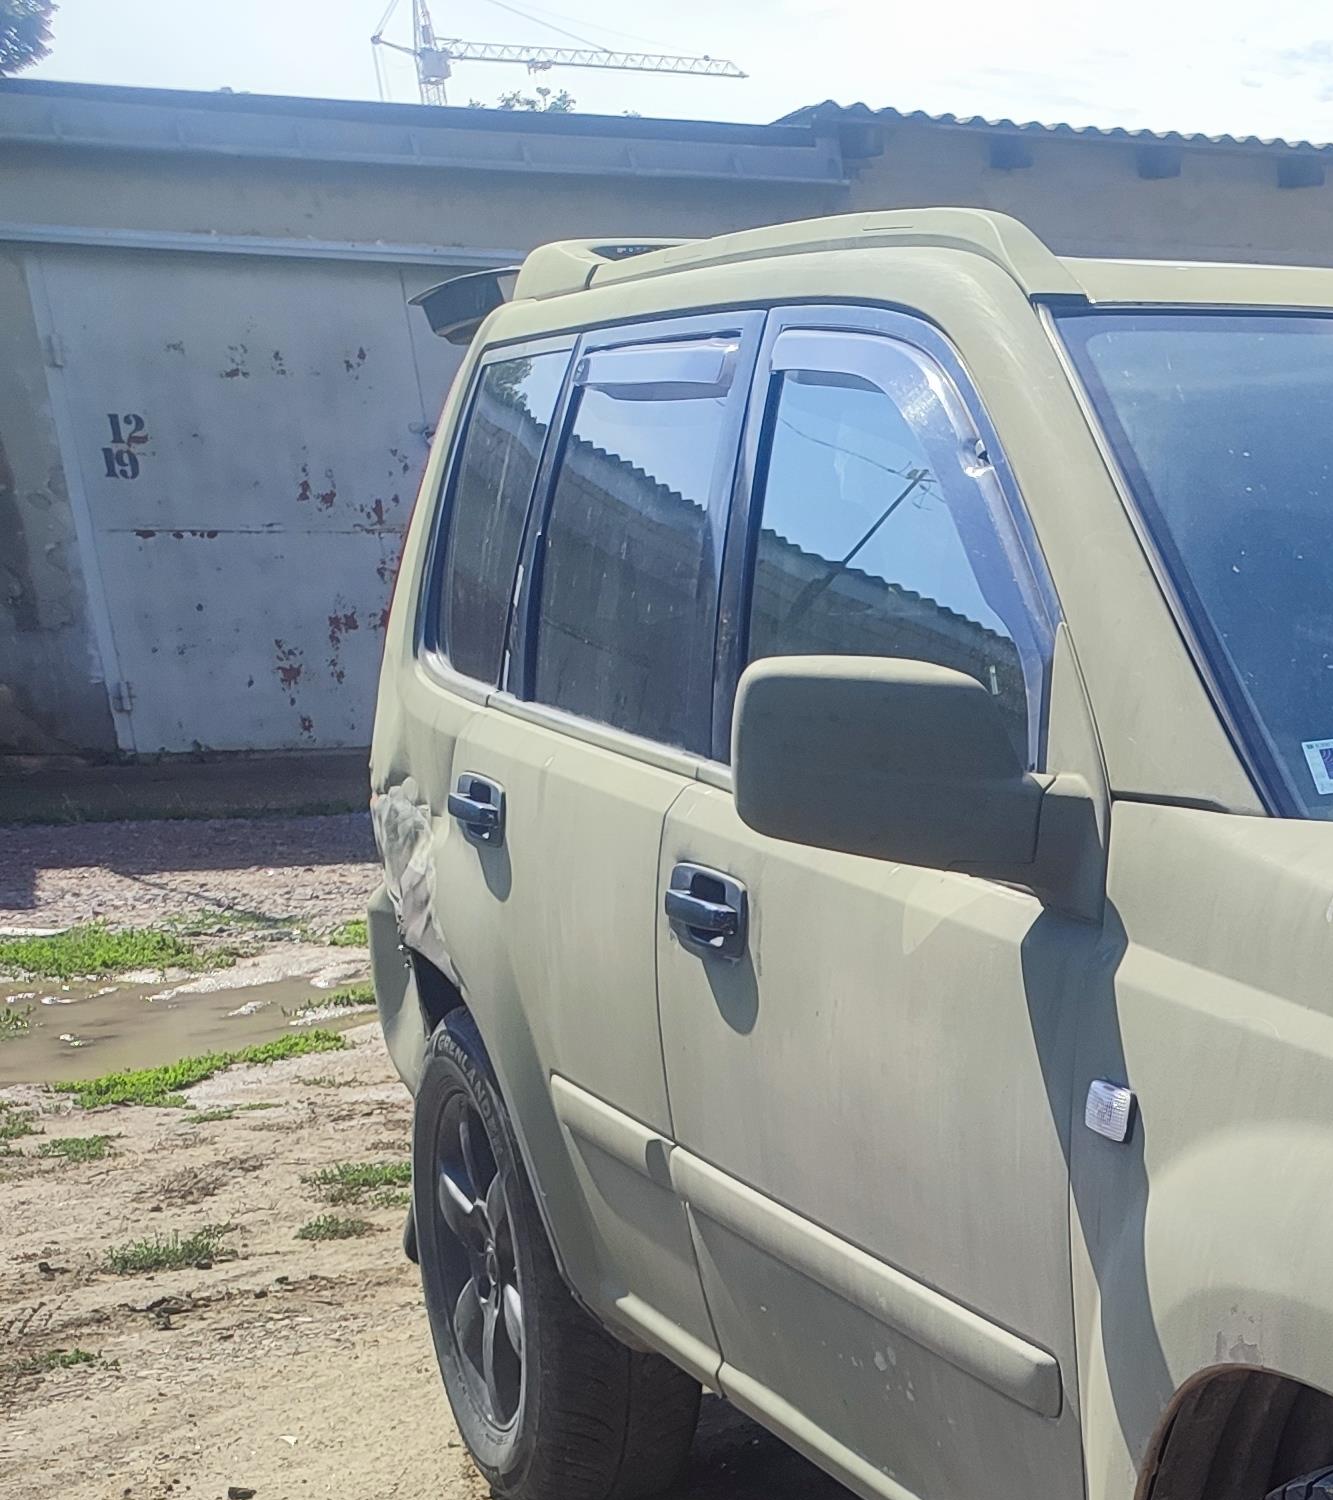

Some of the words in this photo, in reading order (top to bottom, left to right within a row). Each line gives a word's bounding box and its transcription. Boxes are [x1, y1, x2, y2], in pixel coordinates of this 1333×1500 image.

[107, 413, 148, 446] 12
[102, 447, 140, 480] 19
[437, 1035, 504, 1153] GRENLAND
